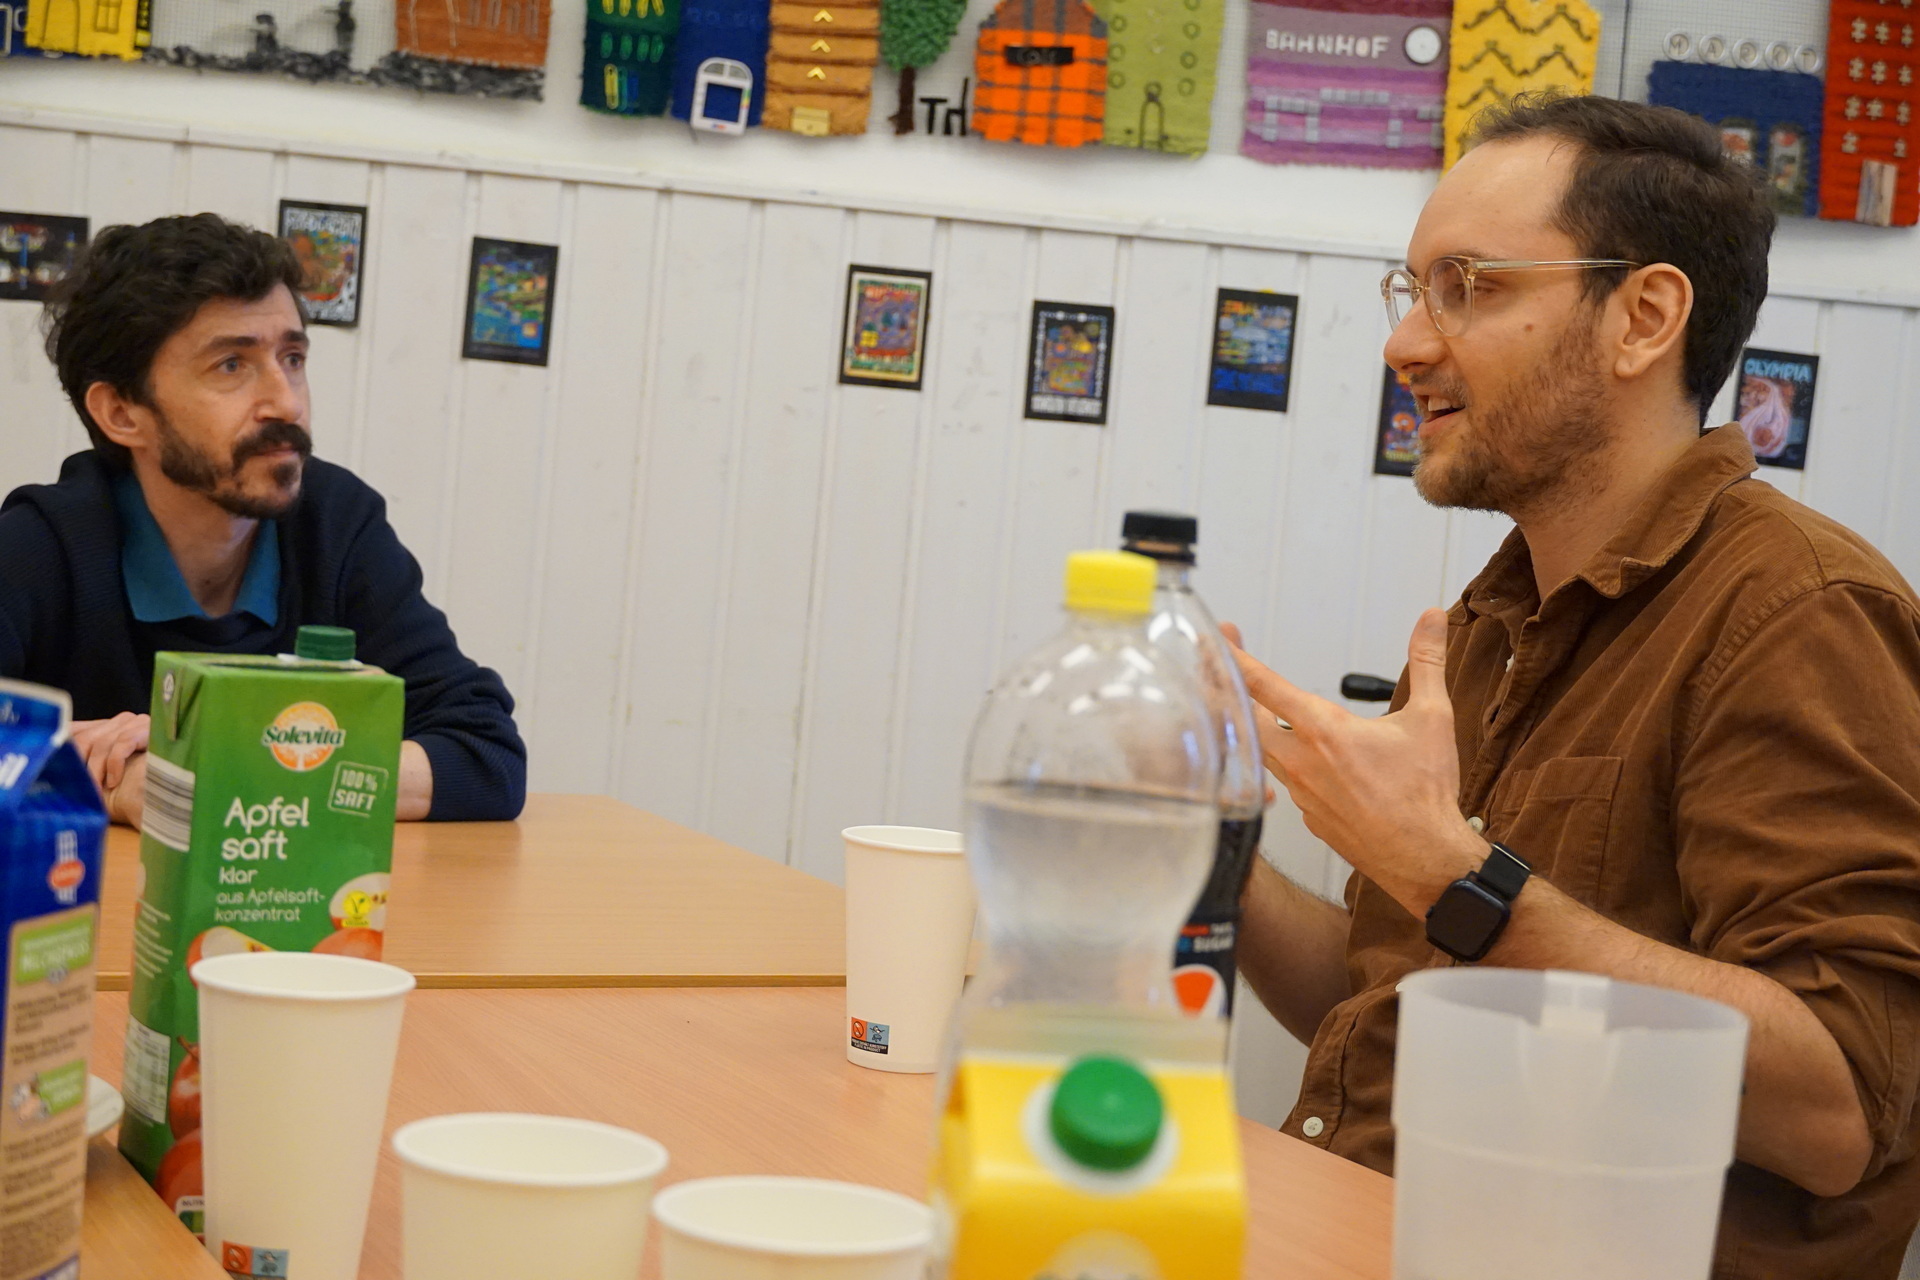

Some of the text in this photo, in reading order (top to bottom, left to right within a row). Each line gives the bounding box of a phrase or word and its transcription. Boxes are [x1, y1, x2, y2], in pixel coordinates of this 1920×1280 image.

[1265, 28, 1390, 59] BAHNHOF
[1744, 358, 1812, 383] OLYMPIA
[263, 724, 344, 747] Solevita
[333, 788, 378, 812] SAFT
[223, 796, 309, 835] Apfel
[221, 830, 289, 861] saft
[218, 866, 258, 884] klar
[216, 887, 326, 906] aus Apfelsaft-
[214, 906, 301, 923] konzentrat
